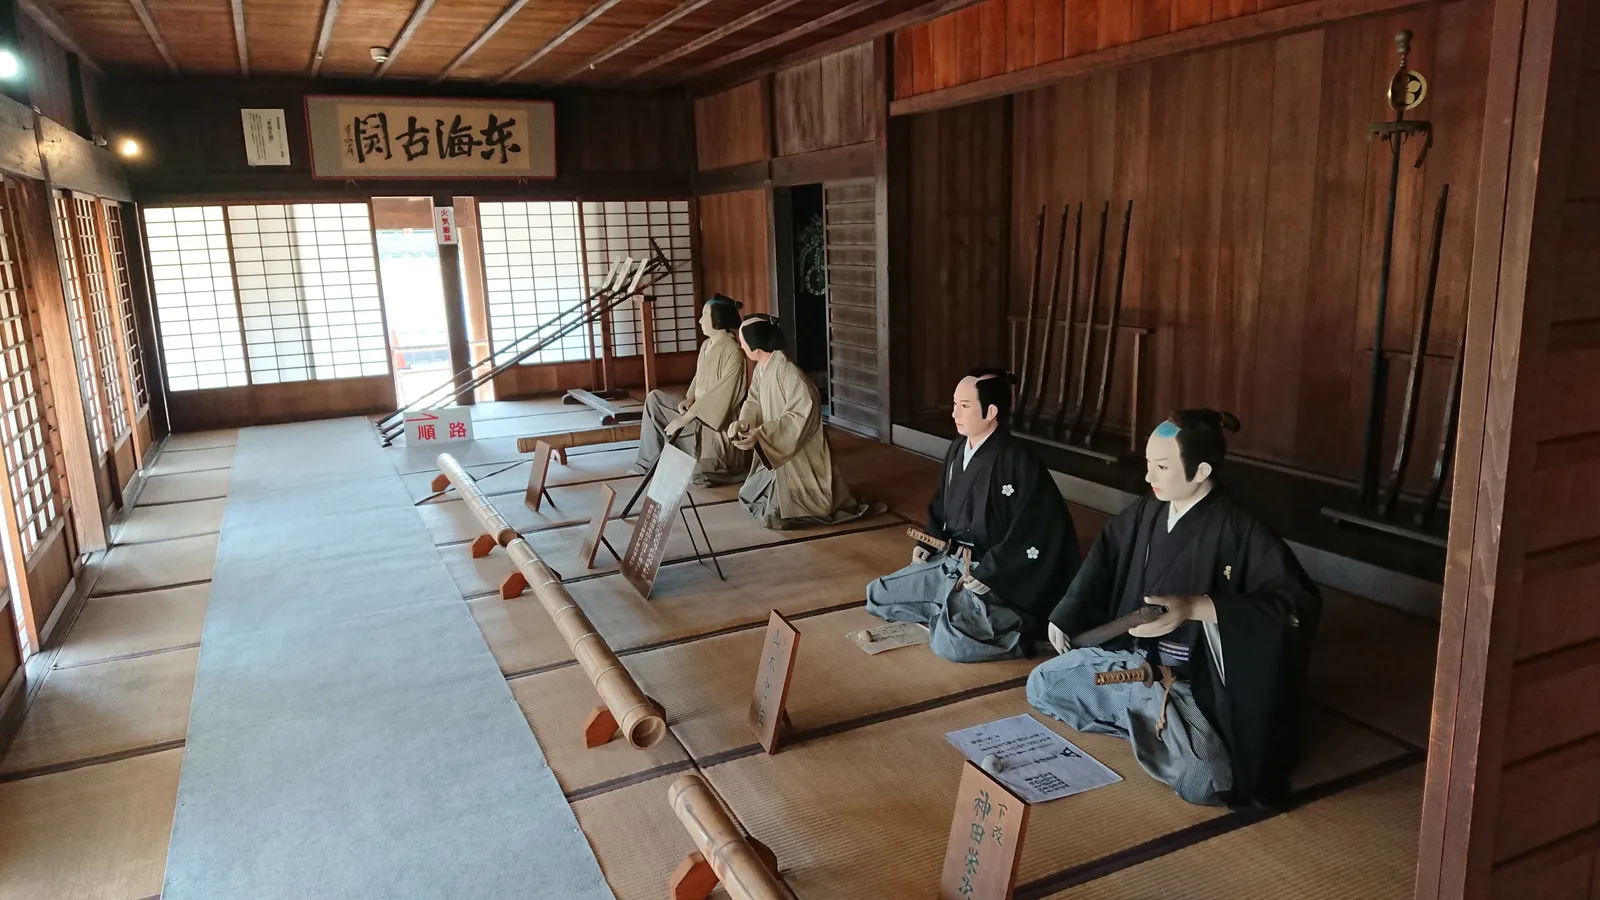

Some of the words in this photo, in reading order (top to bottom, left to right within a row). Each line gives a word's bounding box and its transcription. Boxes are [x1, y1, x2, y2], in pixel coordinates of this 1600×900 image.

[441, 209, 452, 242] 火気厳禁
[418, 422, 466, 440] 順路
